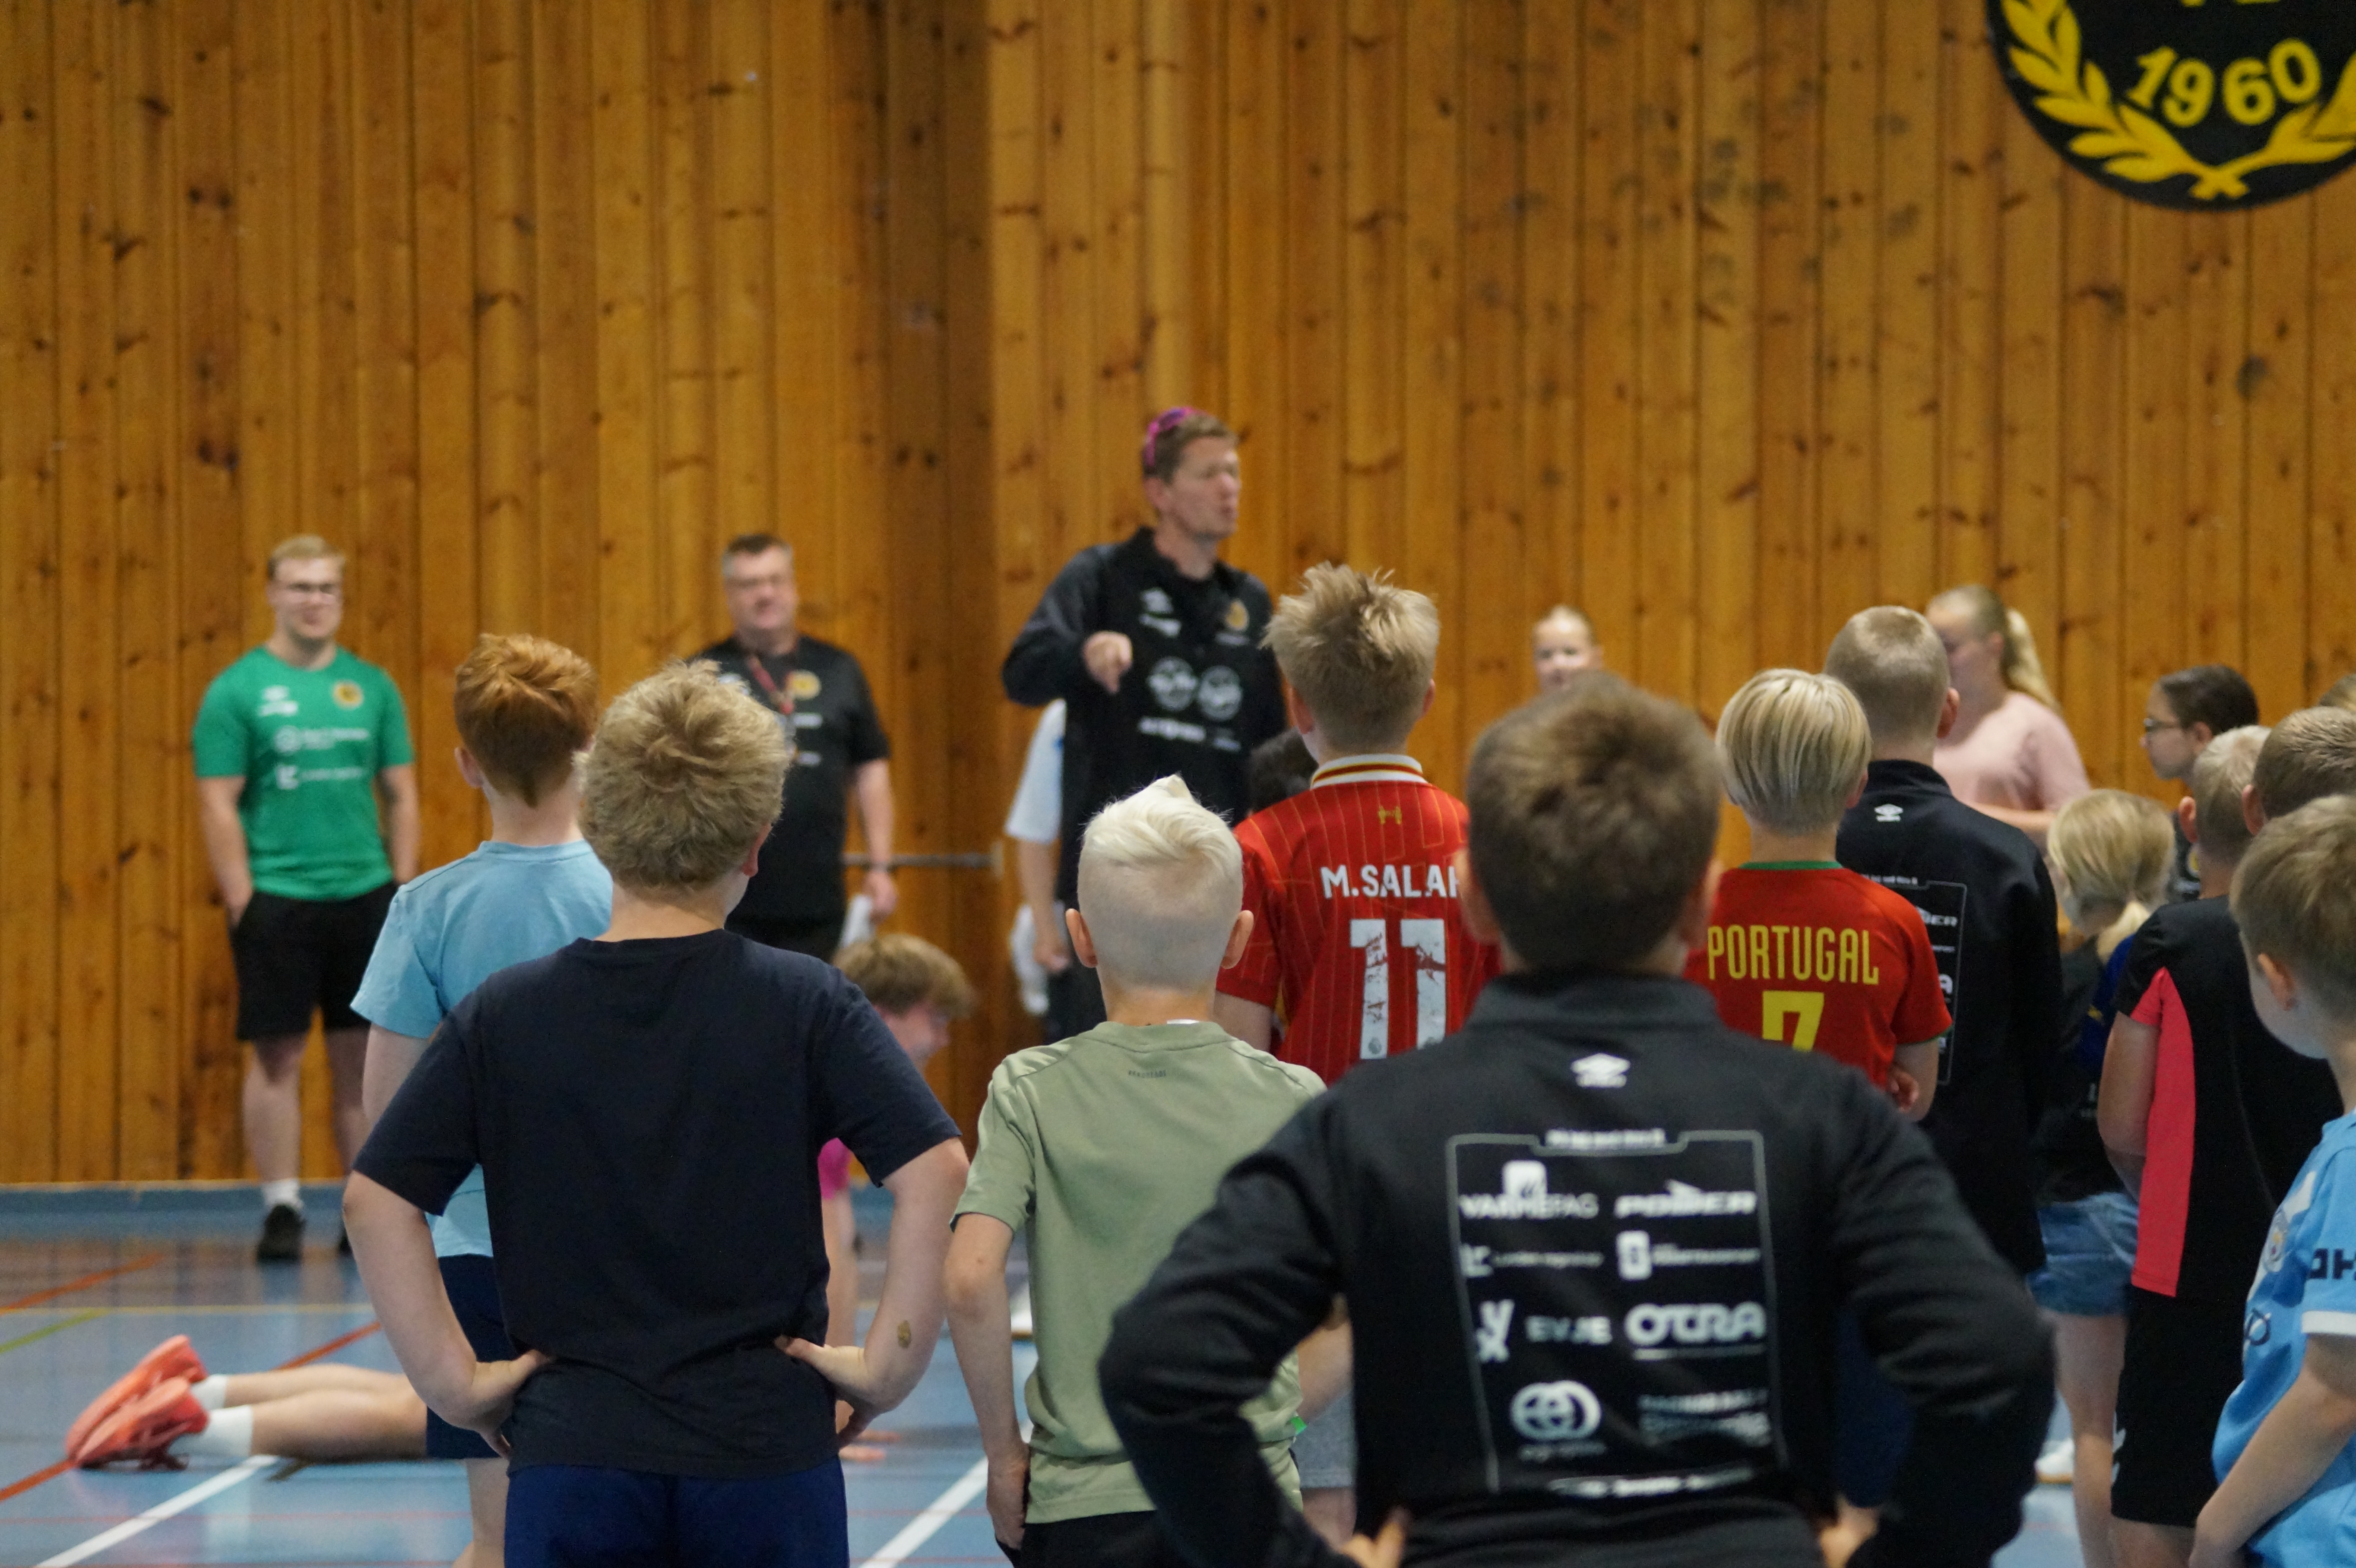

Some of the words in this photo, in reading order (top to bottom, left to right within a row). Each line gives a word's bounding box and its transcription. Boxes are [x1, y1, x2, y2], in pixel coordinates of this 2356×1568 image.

[2127, 38, 2321, 127] 1960
[1708, 924, 1879, 985] PORTUGAL
[1350, 918, 1446, 1059] 11
[1762, 990, 1824, 1052] 7
[1525, 1315, 1612, 1345] EVJE
